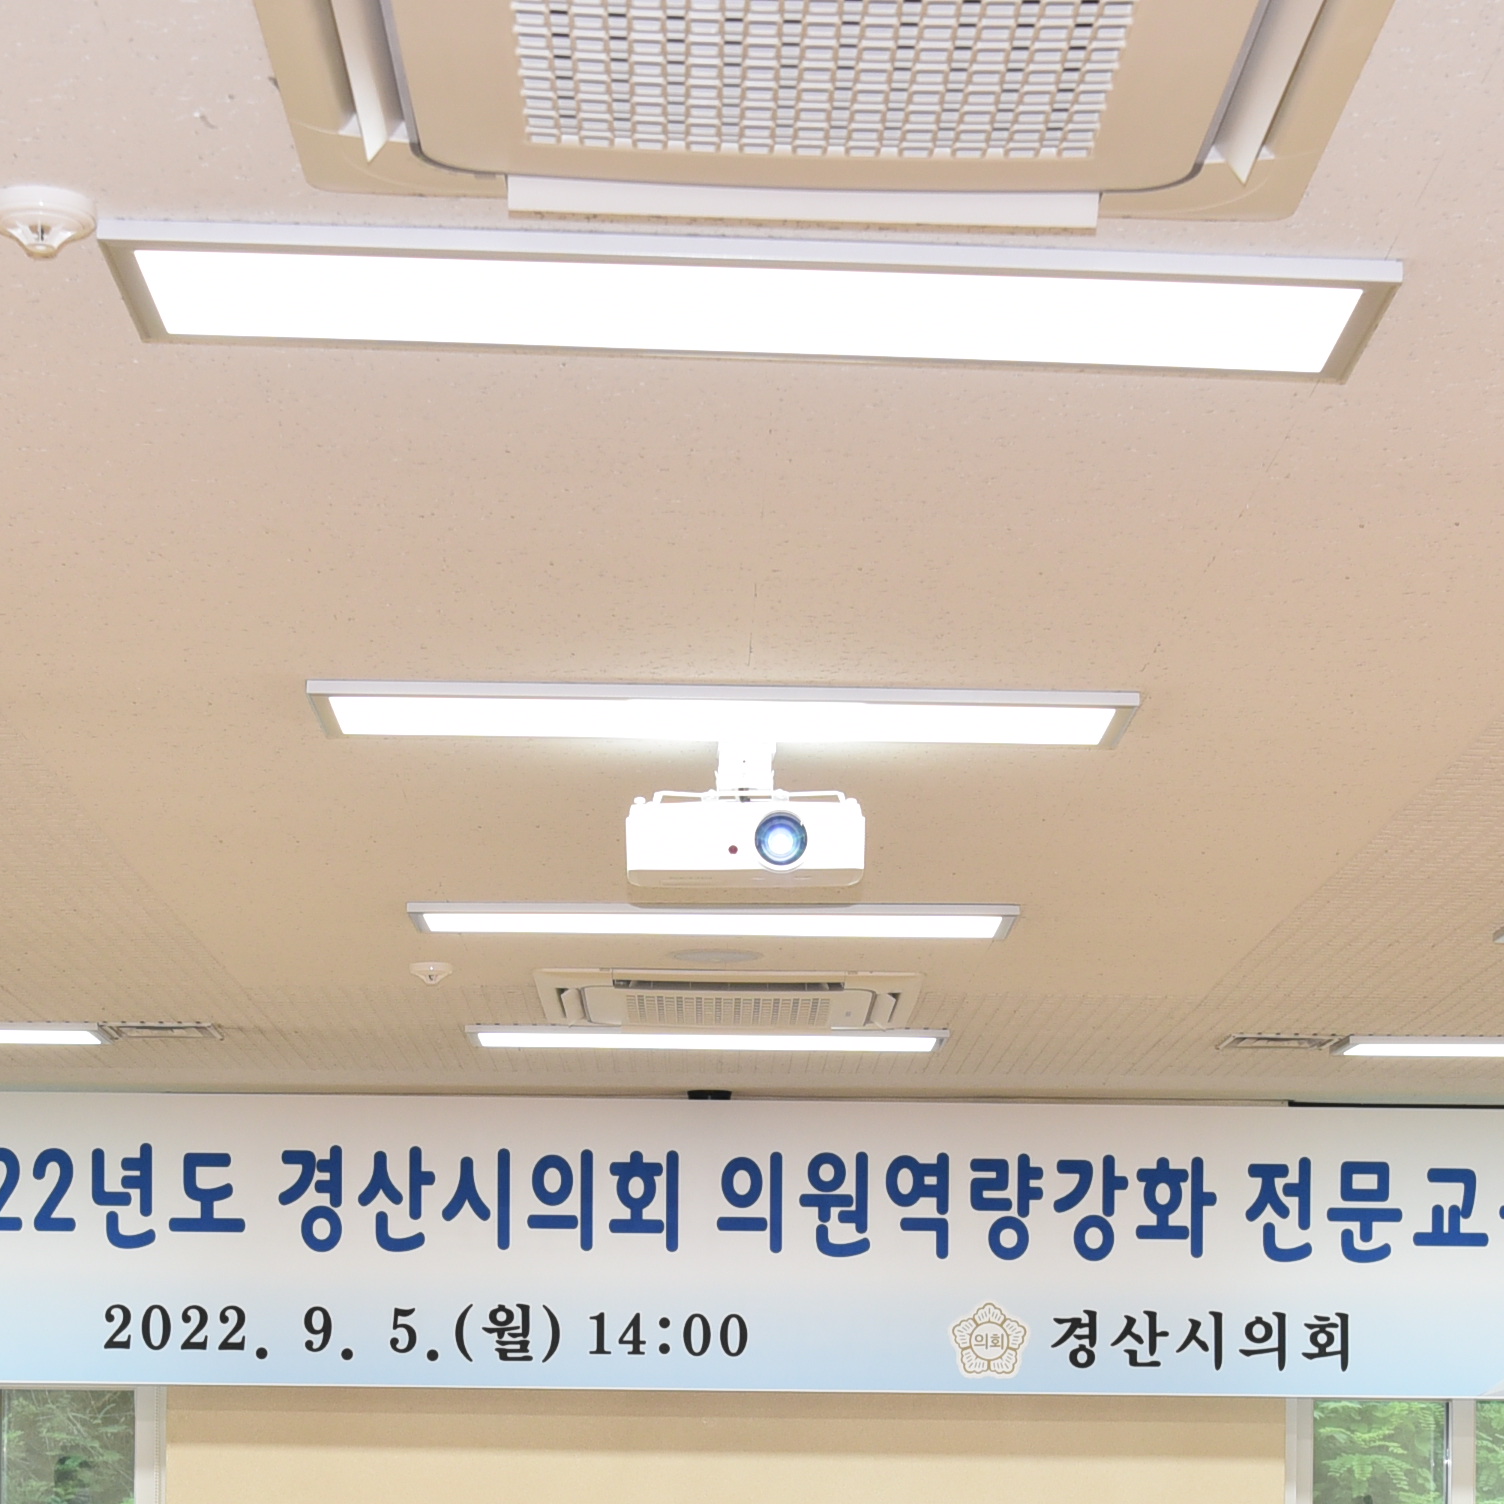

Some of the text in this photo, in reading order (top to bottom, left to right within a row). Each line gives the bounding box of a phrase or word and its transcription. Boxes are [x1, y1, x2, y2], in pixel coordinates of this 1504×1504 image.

[278, 1144, 681, 1253] 경산시의회
[715, 1151, 1219, 1260] 의원역량강화
[103, 1304, 269, 1360] 2022.
[303, 1306, 355, 1361] 9.
[589, 1313, 748, 1357] 14:00
[974, 1333, 1004, 1350] 의회
[1050, 1309, 1350, 1372] 경산시의회
